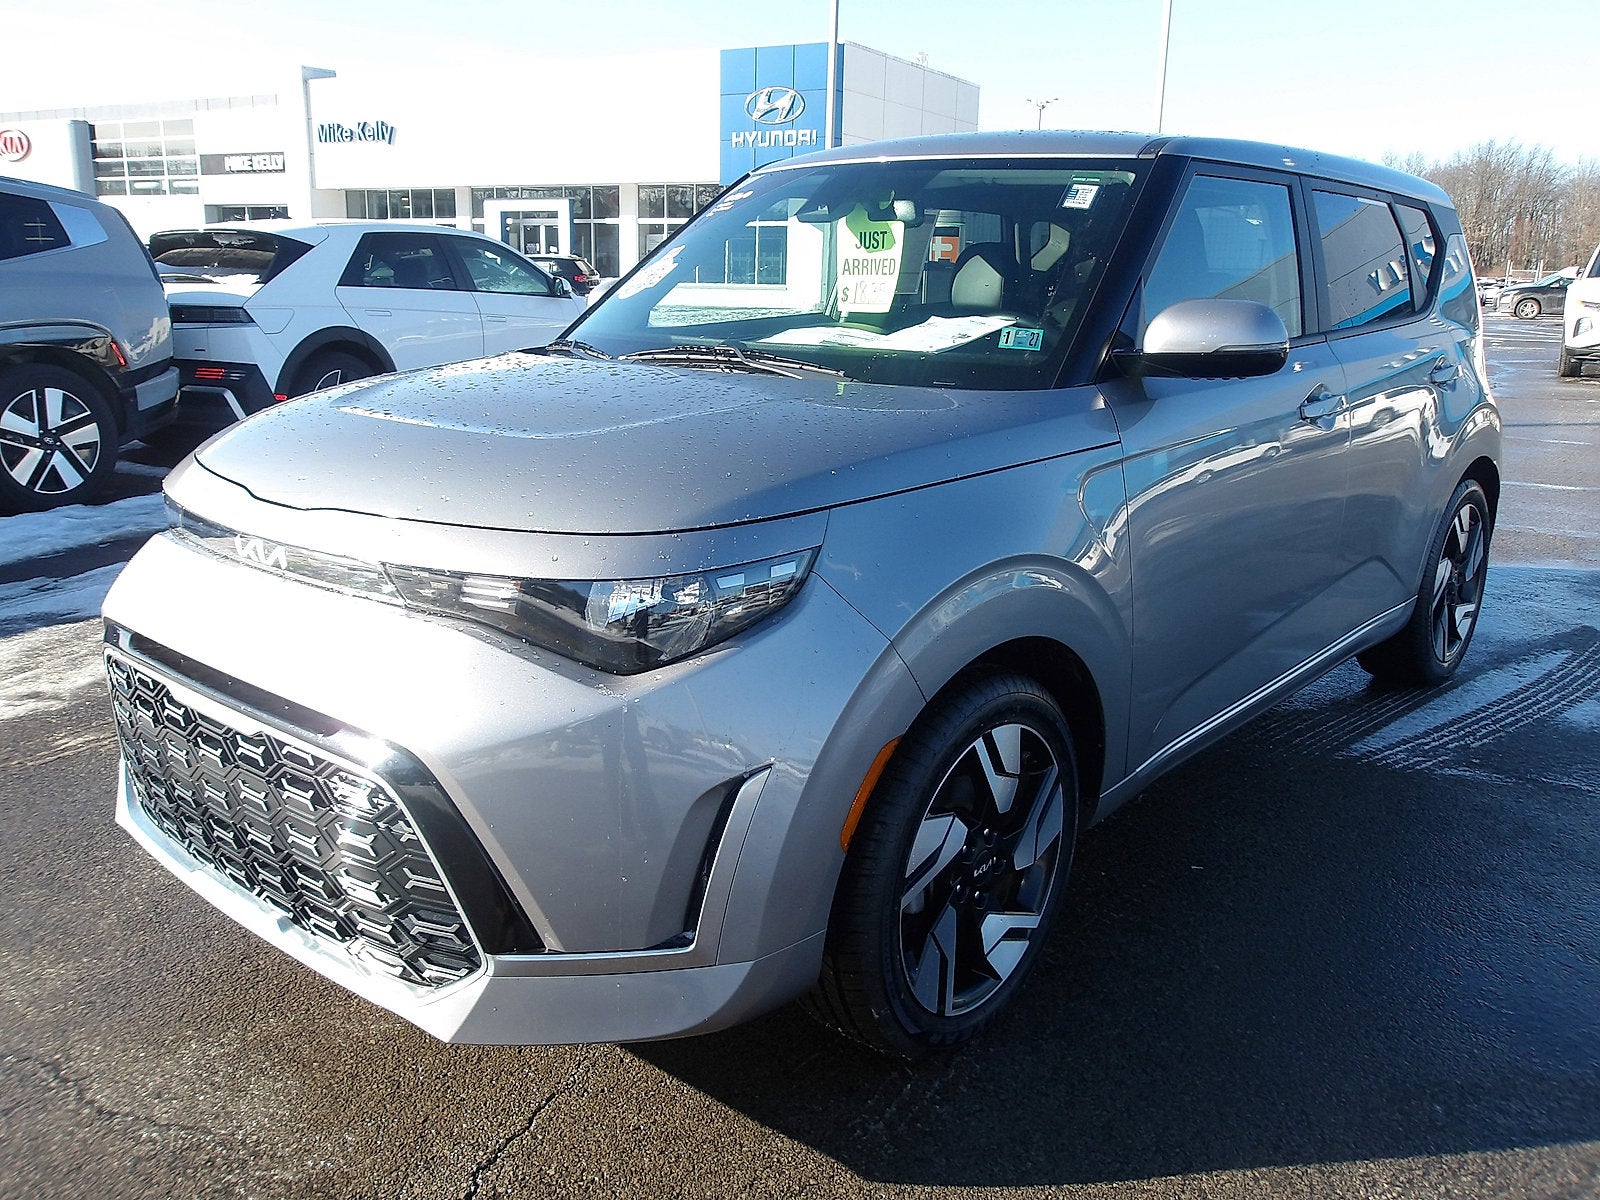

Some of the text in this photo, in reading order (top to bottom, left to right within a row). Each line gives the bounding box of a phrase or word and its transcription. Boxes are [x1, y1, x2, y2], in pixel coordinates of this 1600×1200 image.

[317, 120, 396, 145] Mike Kelly
[731, 129, 817, 148] HYUNDAI
[224, 154, 284, 171] MIKE KELLY
[855, 231, 888, 250] JUST
[842, 258, 896, 276] ARRIVED
[1028, 331, 1040, 347] 27
